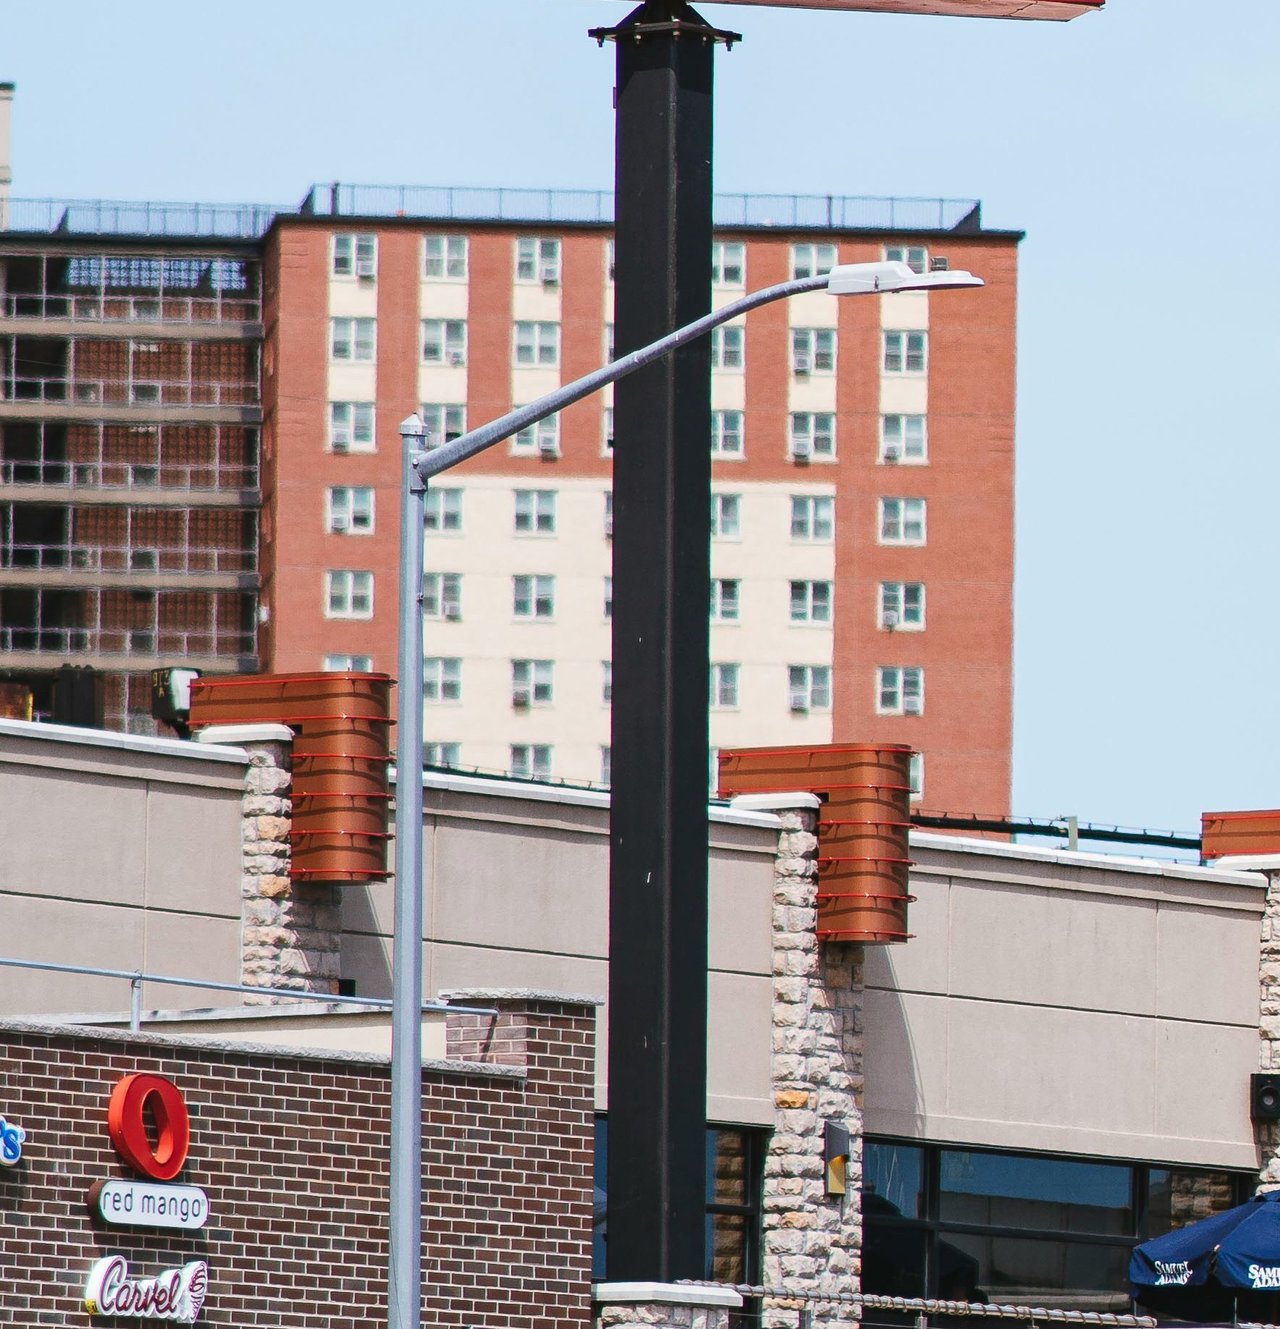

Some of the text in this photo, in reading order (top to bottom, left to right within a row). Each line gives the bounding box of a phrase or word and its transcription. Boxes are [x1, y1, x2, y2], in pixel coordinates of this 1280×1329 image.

[103, 1187, 201, 1223] red mango
[1154, 1260, 1193, 1276] SAMUEL
[1154, 1272, 1191, 1286] ADAMS
[99, 1259, 182, 1314] Carvel
